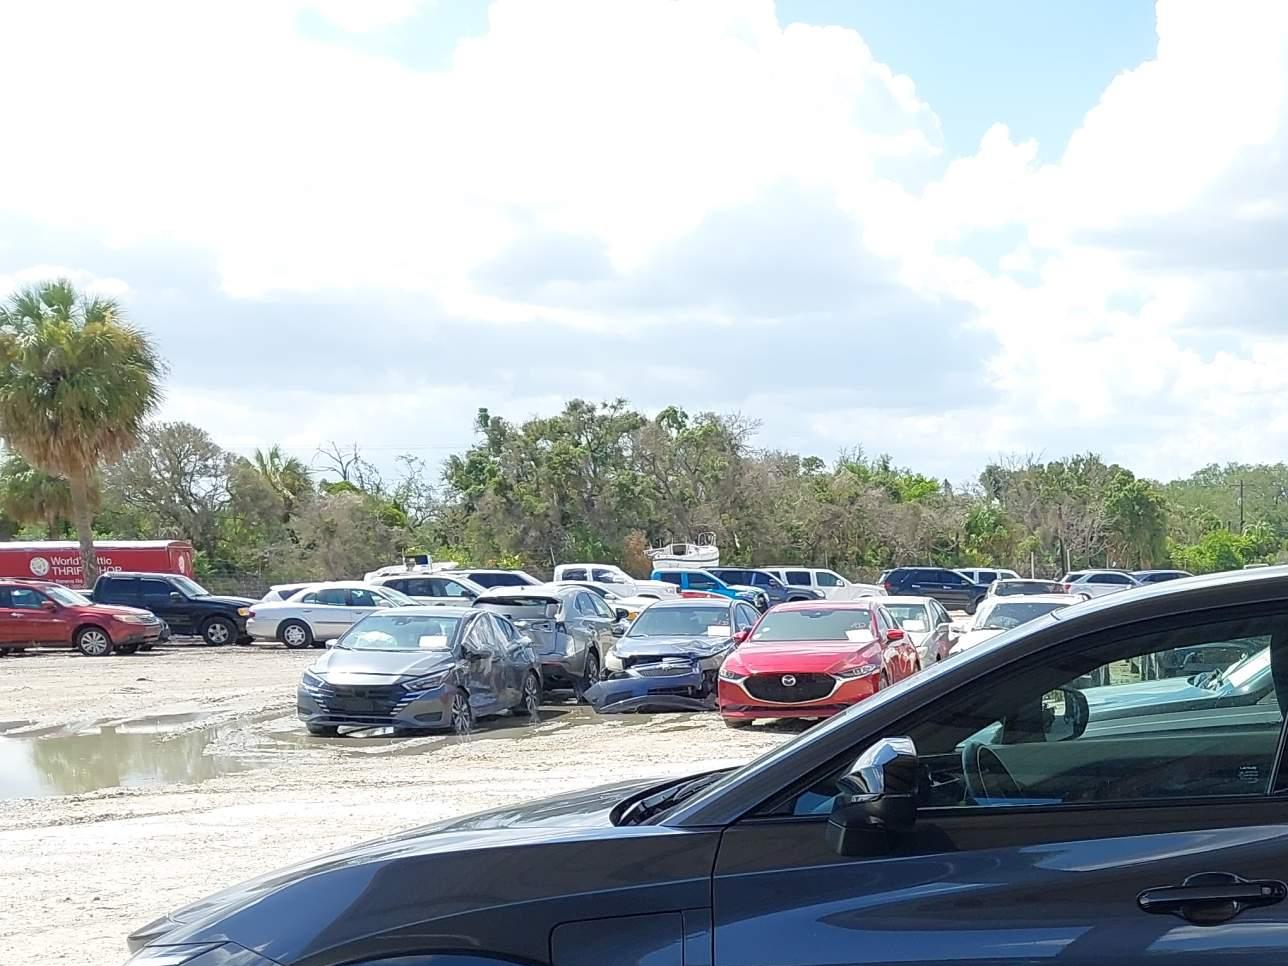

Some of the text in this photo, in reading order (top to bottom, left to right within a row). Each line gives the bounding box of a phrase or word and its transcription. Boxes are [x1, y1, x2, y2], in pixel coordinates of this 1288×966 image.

[50, 556, 83, 566] World'
[51, 566, 122, 576] THRIF HOP
